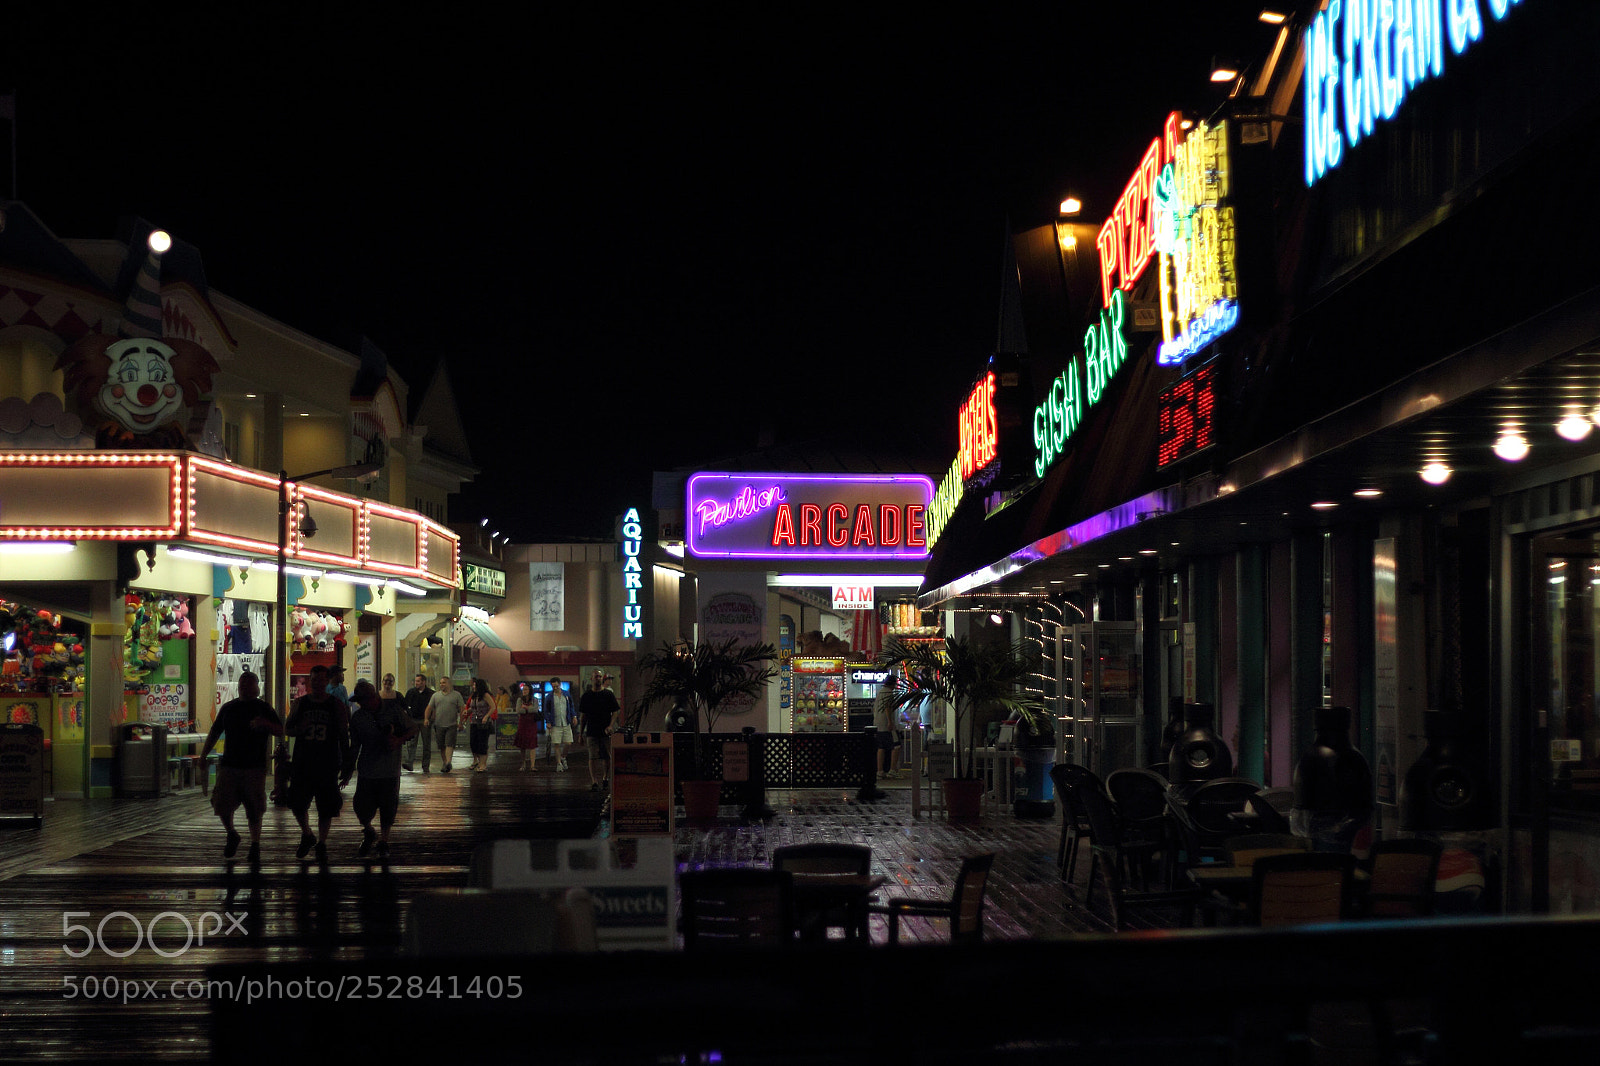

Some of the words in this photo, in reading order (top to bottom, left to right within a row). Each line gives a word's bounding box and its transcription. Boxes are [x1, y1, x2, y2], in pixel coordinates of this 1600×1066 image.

[1304, 0, 1342, 188] ICE
[1097, 111, 1178, 309] PIZZA
[1033, 355, 1082, 479] SUSHI
[1084, 287, 1128, 408] BAR
[694, 483, 788, 540] Pavilion
[772, 502, 926, 547] ARCADE
[924, 452, 964, 554] LEMONADE
[623, 507, 642, 638] AQUARIUM
[834, 586, 872, 602] ATM
